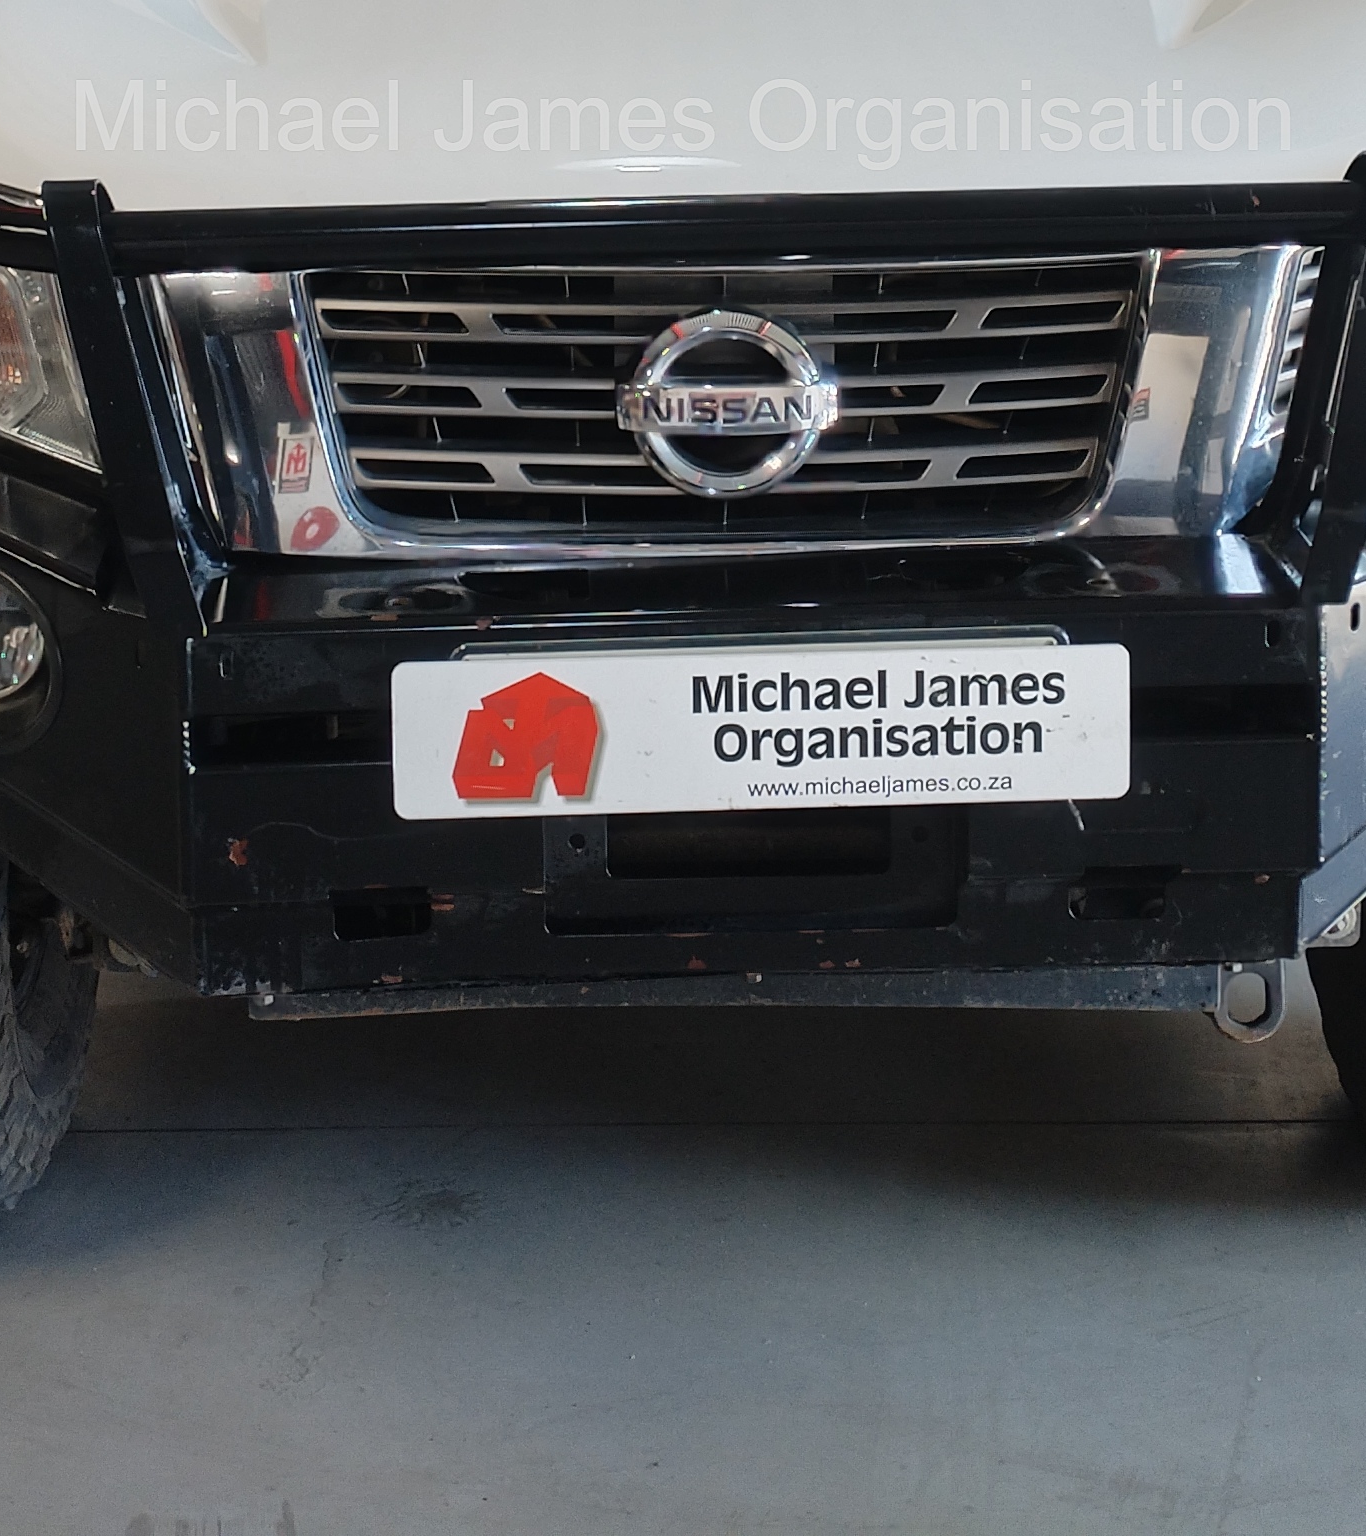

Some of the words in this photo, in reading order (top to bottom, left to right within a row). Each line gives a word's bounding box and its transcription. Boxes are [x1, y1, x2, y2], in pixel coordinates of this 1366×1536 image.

[642, 394, 812, 424] NISSAN
[692, 669, 887, 714] Michael
[903, 669, 1066, 709] James
[713, 715, 1043, 768] Organisation
[747, 775, 1013, 798] www.michaeljames.co.za
